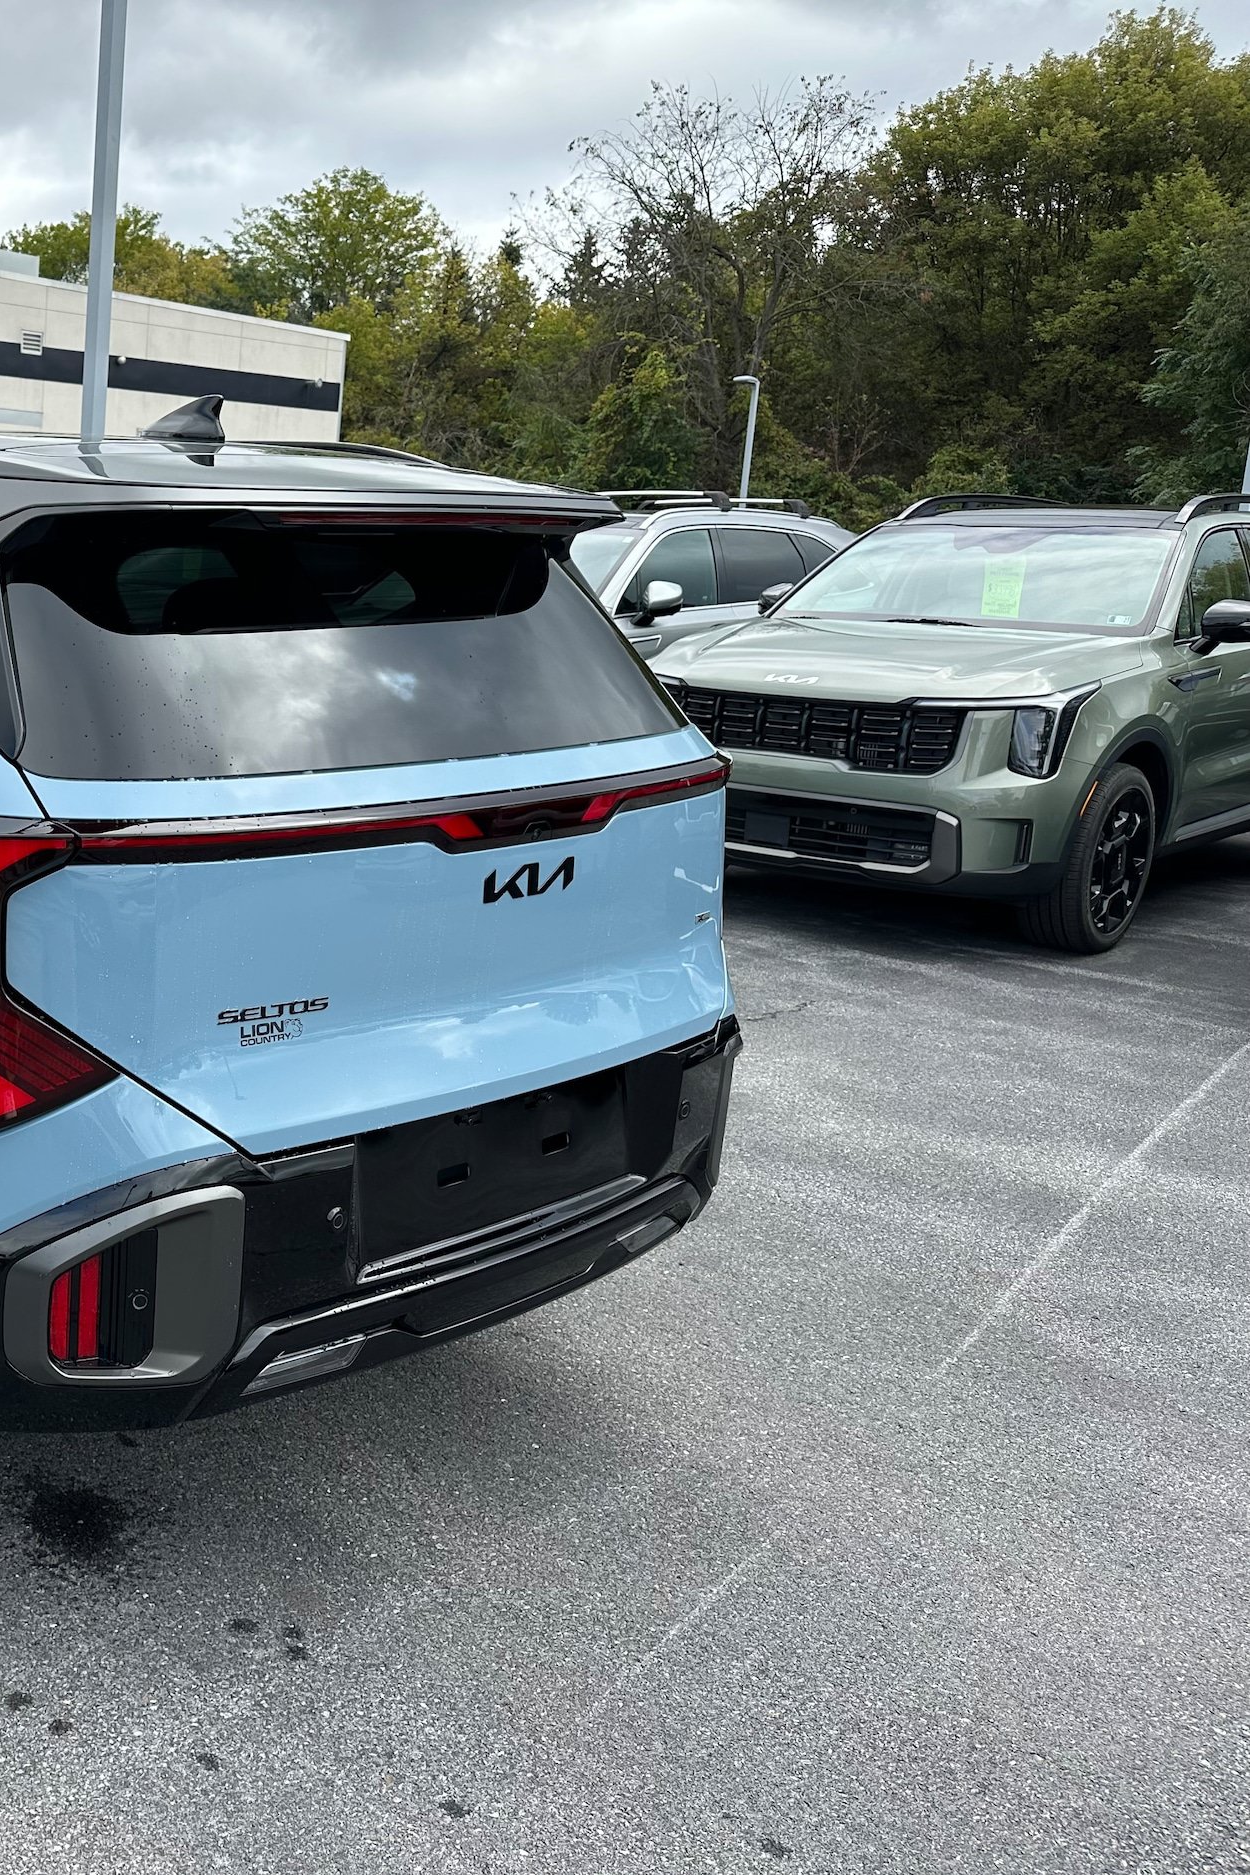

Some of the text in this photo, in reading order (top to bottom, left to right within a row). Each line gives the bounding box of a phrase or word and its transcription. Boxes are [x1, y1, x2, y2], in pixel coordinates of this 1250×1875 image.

[482, 855, 575, 904] KIA
[216, 996, 329, 1026] SELTOS
[240, 1020, 285, 1039] LION
[240, 1032, 292, 1047] COUNTRY
